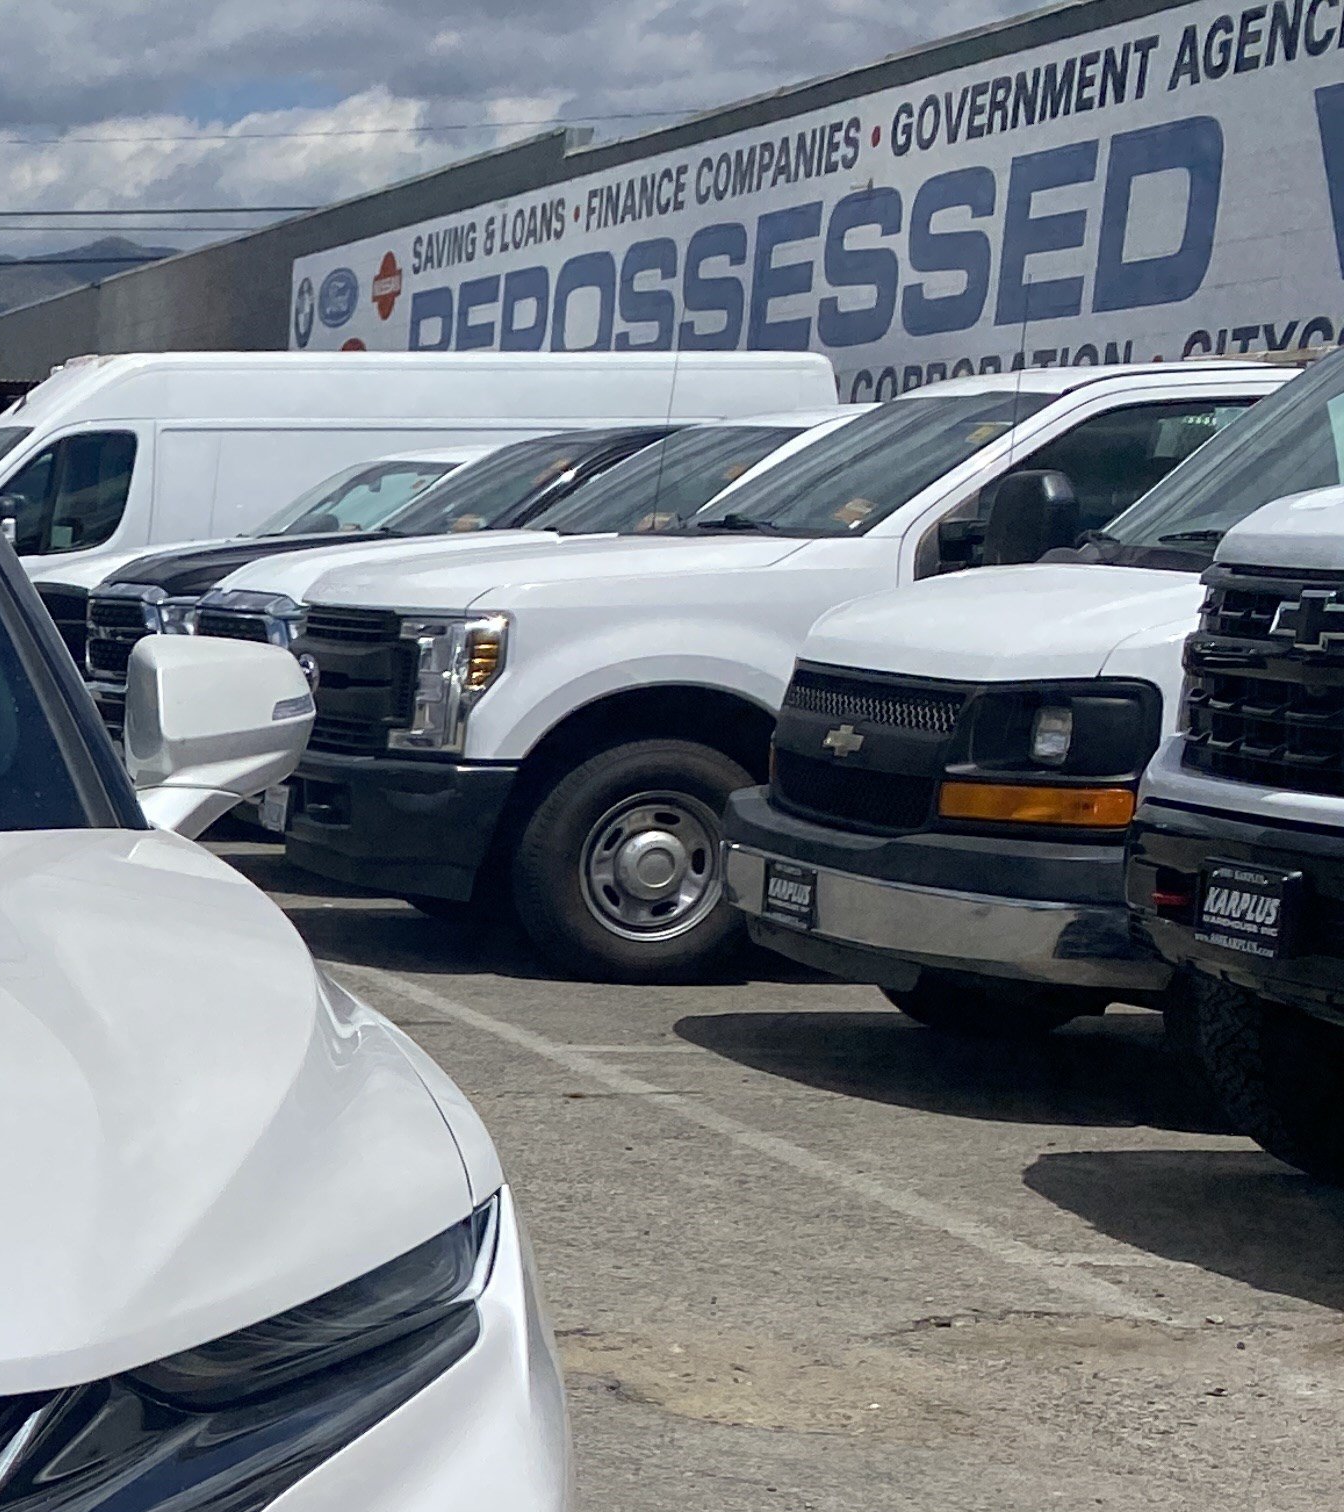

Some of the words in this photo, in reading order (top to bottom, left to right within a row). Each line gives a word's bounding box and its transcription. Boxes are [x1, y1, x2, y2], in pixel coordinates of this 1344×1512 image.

[412, 221, 477, 275] SAVING
[483, 215, 496, 257] &
[499, 197, 567, 254] LOANS
[585, 164, 689, 233] FINANCE
[695, 115, 862, 206] COMPANIES
[890, 34, 1161, 157] GOVERNMENT
[1166, 0, 1344, 93] AGENC
[1204, 886, 1281, 925] KARPLUS
